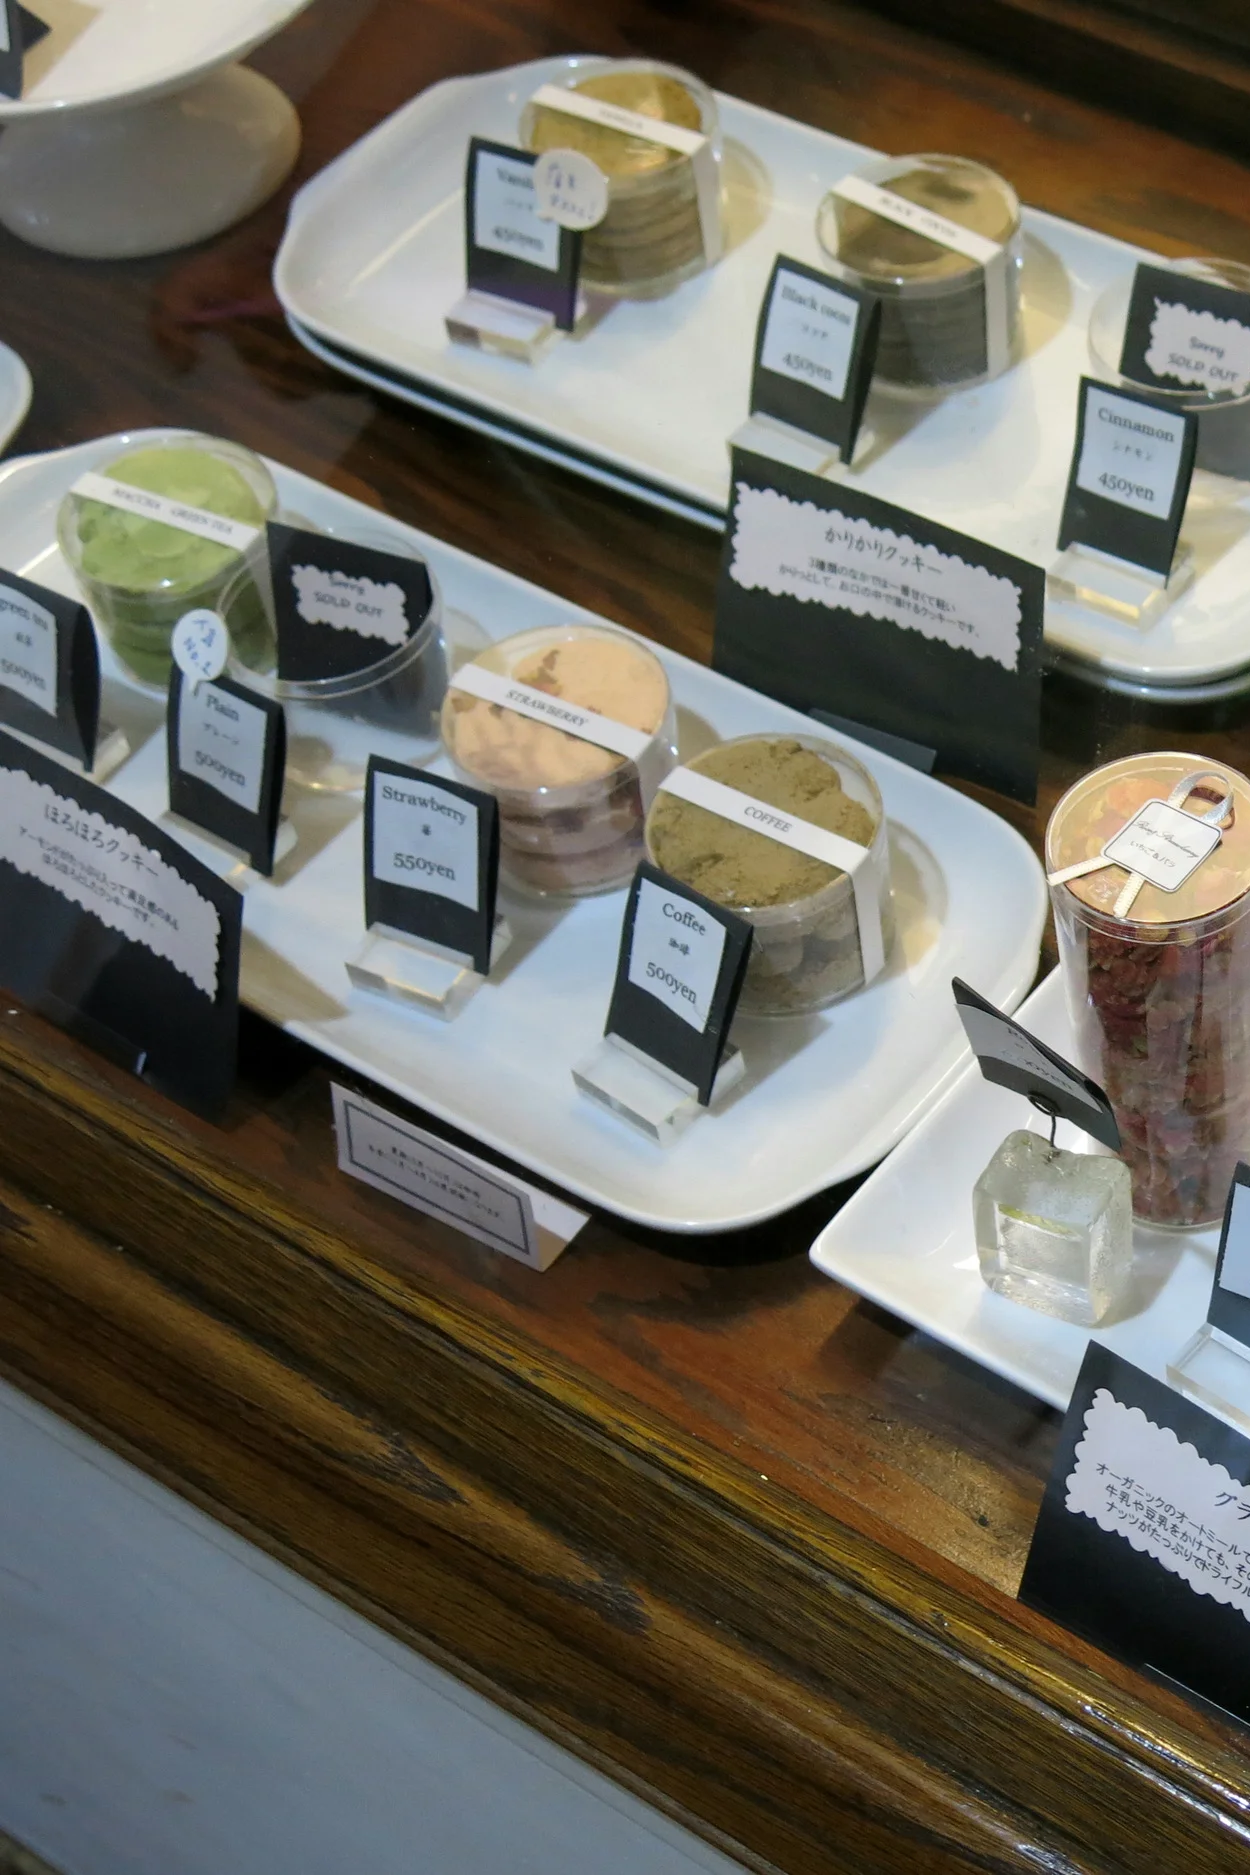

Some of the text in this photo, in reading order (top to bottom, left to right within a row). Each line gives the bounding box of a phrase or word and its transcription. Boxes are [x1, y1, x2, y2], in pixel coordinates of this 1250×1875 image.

[781, 285, 817, 311] Black
[1189, 336, 1225, 360] Sorry
[783, 352, 833, 382] 450yen
[1168, 352, 1239, 384] SOLD OUT
[1098, 406, 1174, 443] Cinnamon
[1098, 471, 1155, 502] 450yen
[824, 525, 944, 576] かりかりクッキー
[314, 590, 383, 618] SOLD OUT
[205, 693, 240, 723] Plain
[506, 689, 589, 728] STRAWBERRY
[195, 750, 247, 789] 500yen
[382, 784, 467, 827] Strawberry
[743, 805, 793, 834] COFFEE
[44, 803, 159, 877] ほろほろクッキー
[393, 852, 456, 882] 550yen
[662, 902, 707, 937] Coffee
[645, 962, 698, 1005] 500yen
